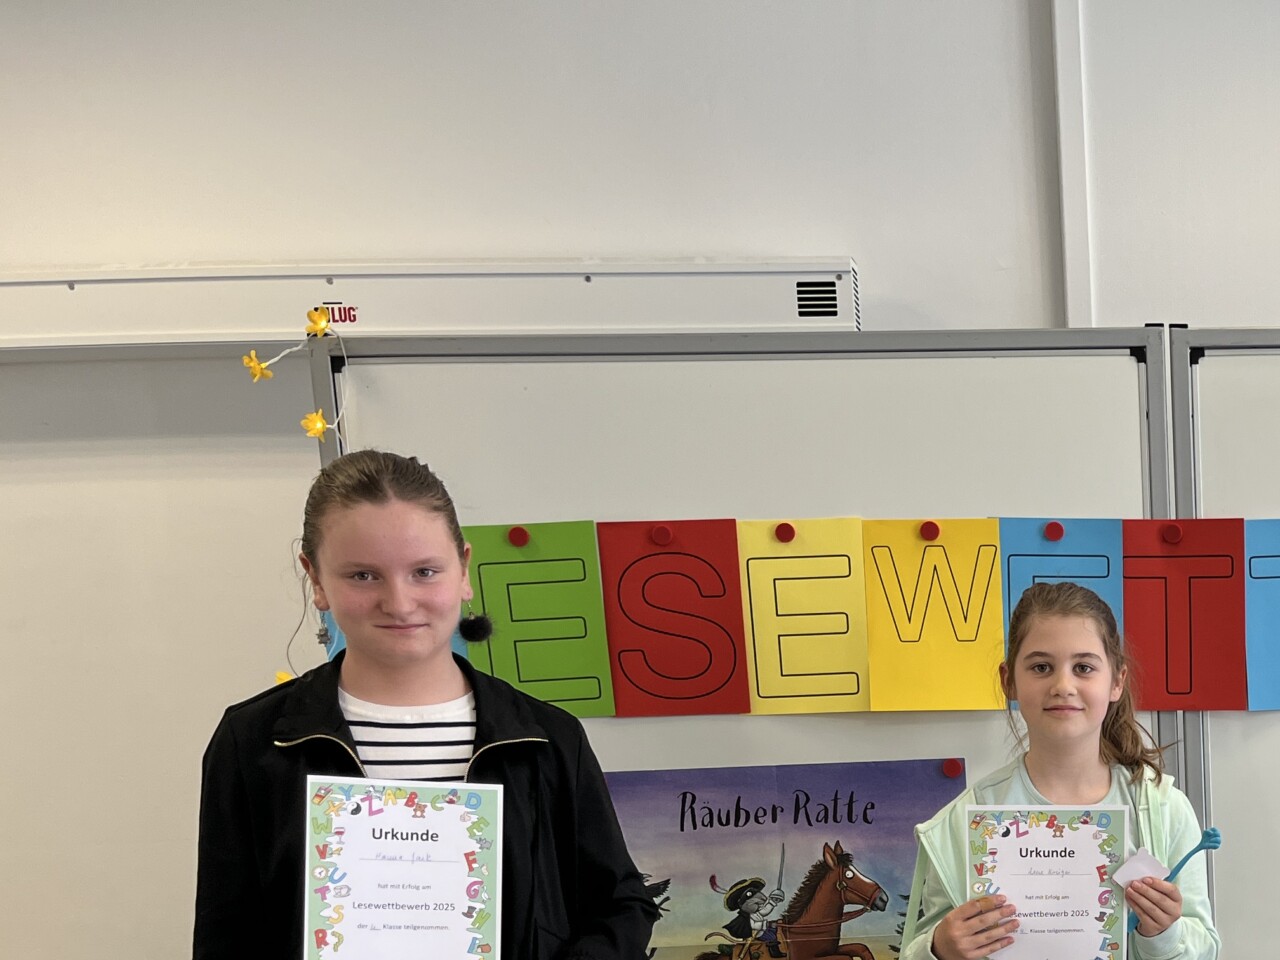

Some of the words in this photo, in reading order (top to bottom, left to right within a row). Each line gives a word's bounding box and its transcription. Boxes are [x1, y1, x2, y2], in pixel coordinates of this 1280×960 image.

[678, 791, 784, 832] Räuber
[793, 790, 875, 826] Ratte
[372, 828, 439, 841] Urkunde
[1020, 848, 1075, 858] Urkunde
[402, 883, 420, 891] Erfolg
[352, 902, 430, 911] Lesewettbewerb
[433, 903, 455, 911] 2025
